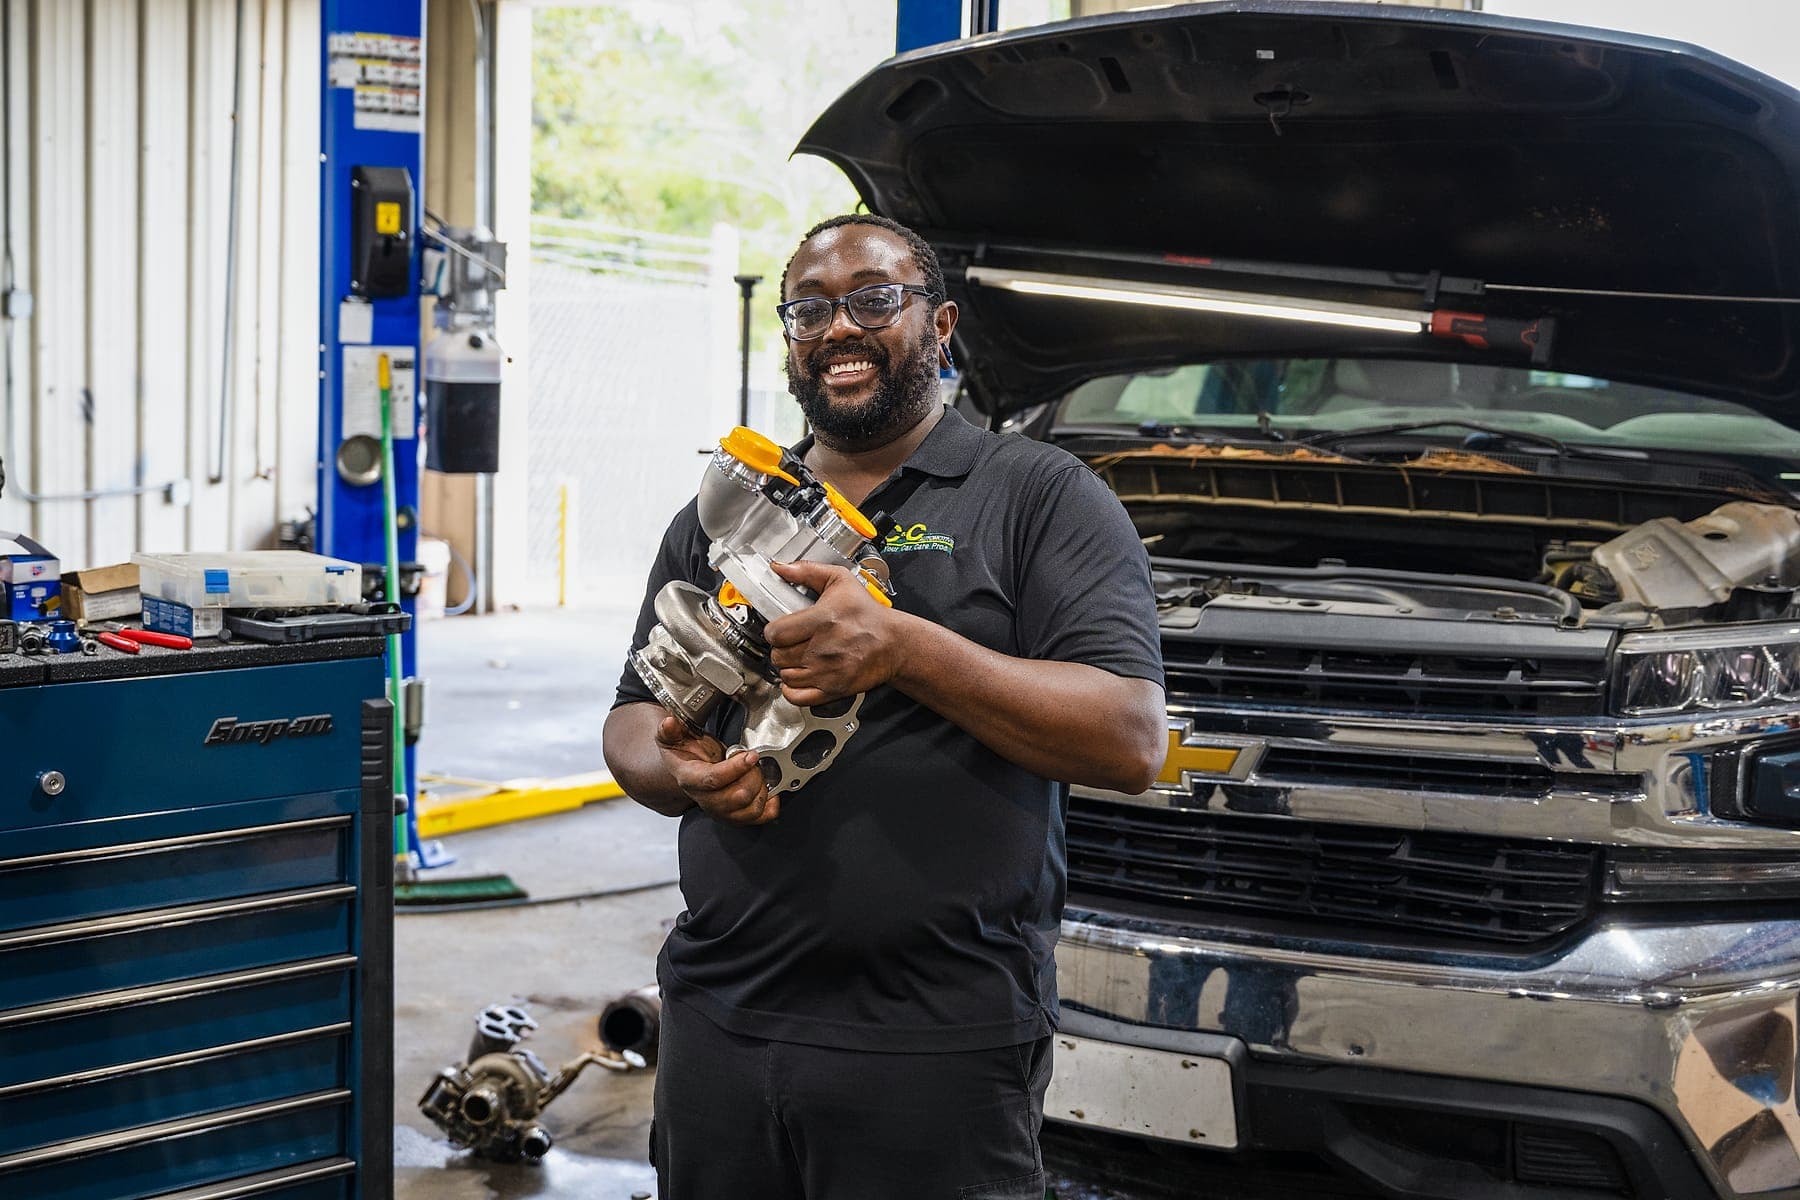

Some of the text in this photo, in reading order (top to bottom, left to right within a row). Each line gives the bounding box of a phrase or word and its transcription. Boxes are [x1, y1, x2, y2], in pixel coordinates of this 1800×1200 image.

[884, 545, 899, 553] Your
[900, 544, 912, 552] Car
[914, 543, 930, 551] Care
